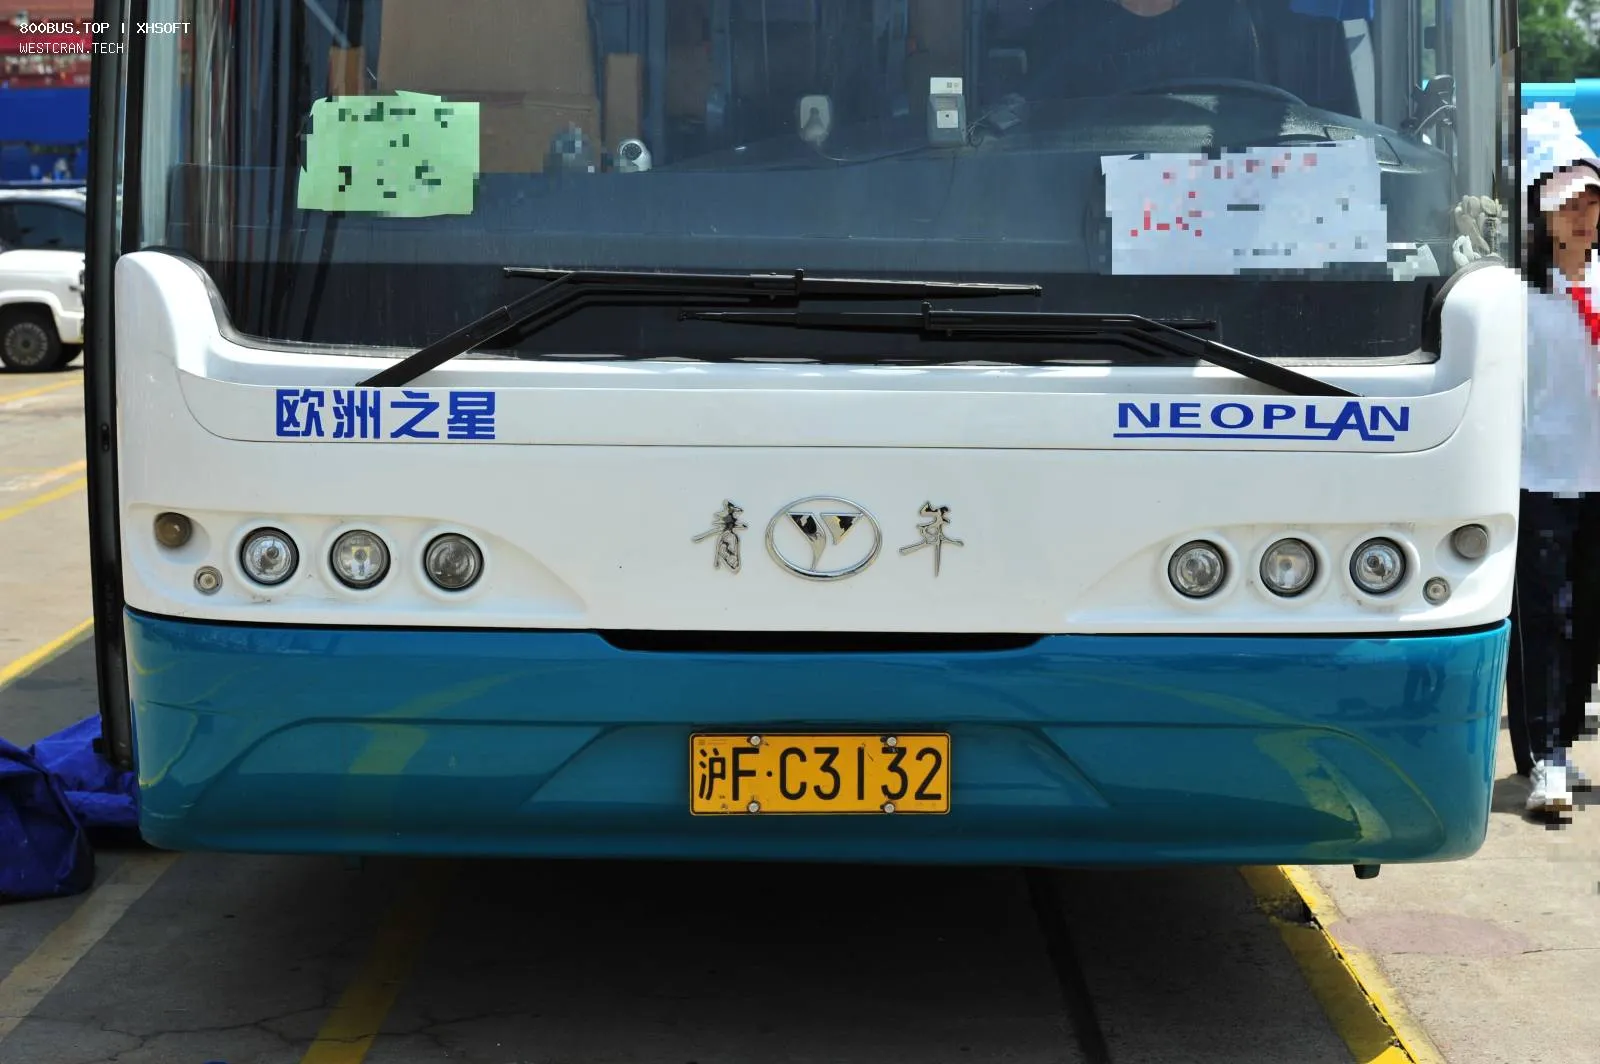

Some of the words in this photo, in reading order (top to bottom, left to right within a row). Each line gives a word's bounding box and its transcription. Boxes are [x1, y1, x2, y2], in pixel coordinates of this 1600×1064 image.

[276, 389, 496, 440] 欧洲之星
[1113, 401, 1410, 442] NEOPLAN
